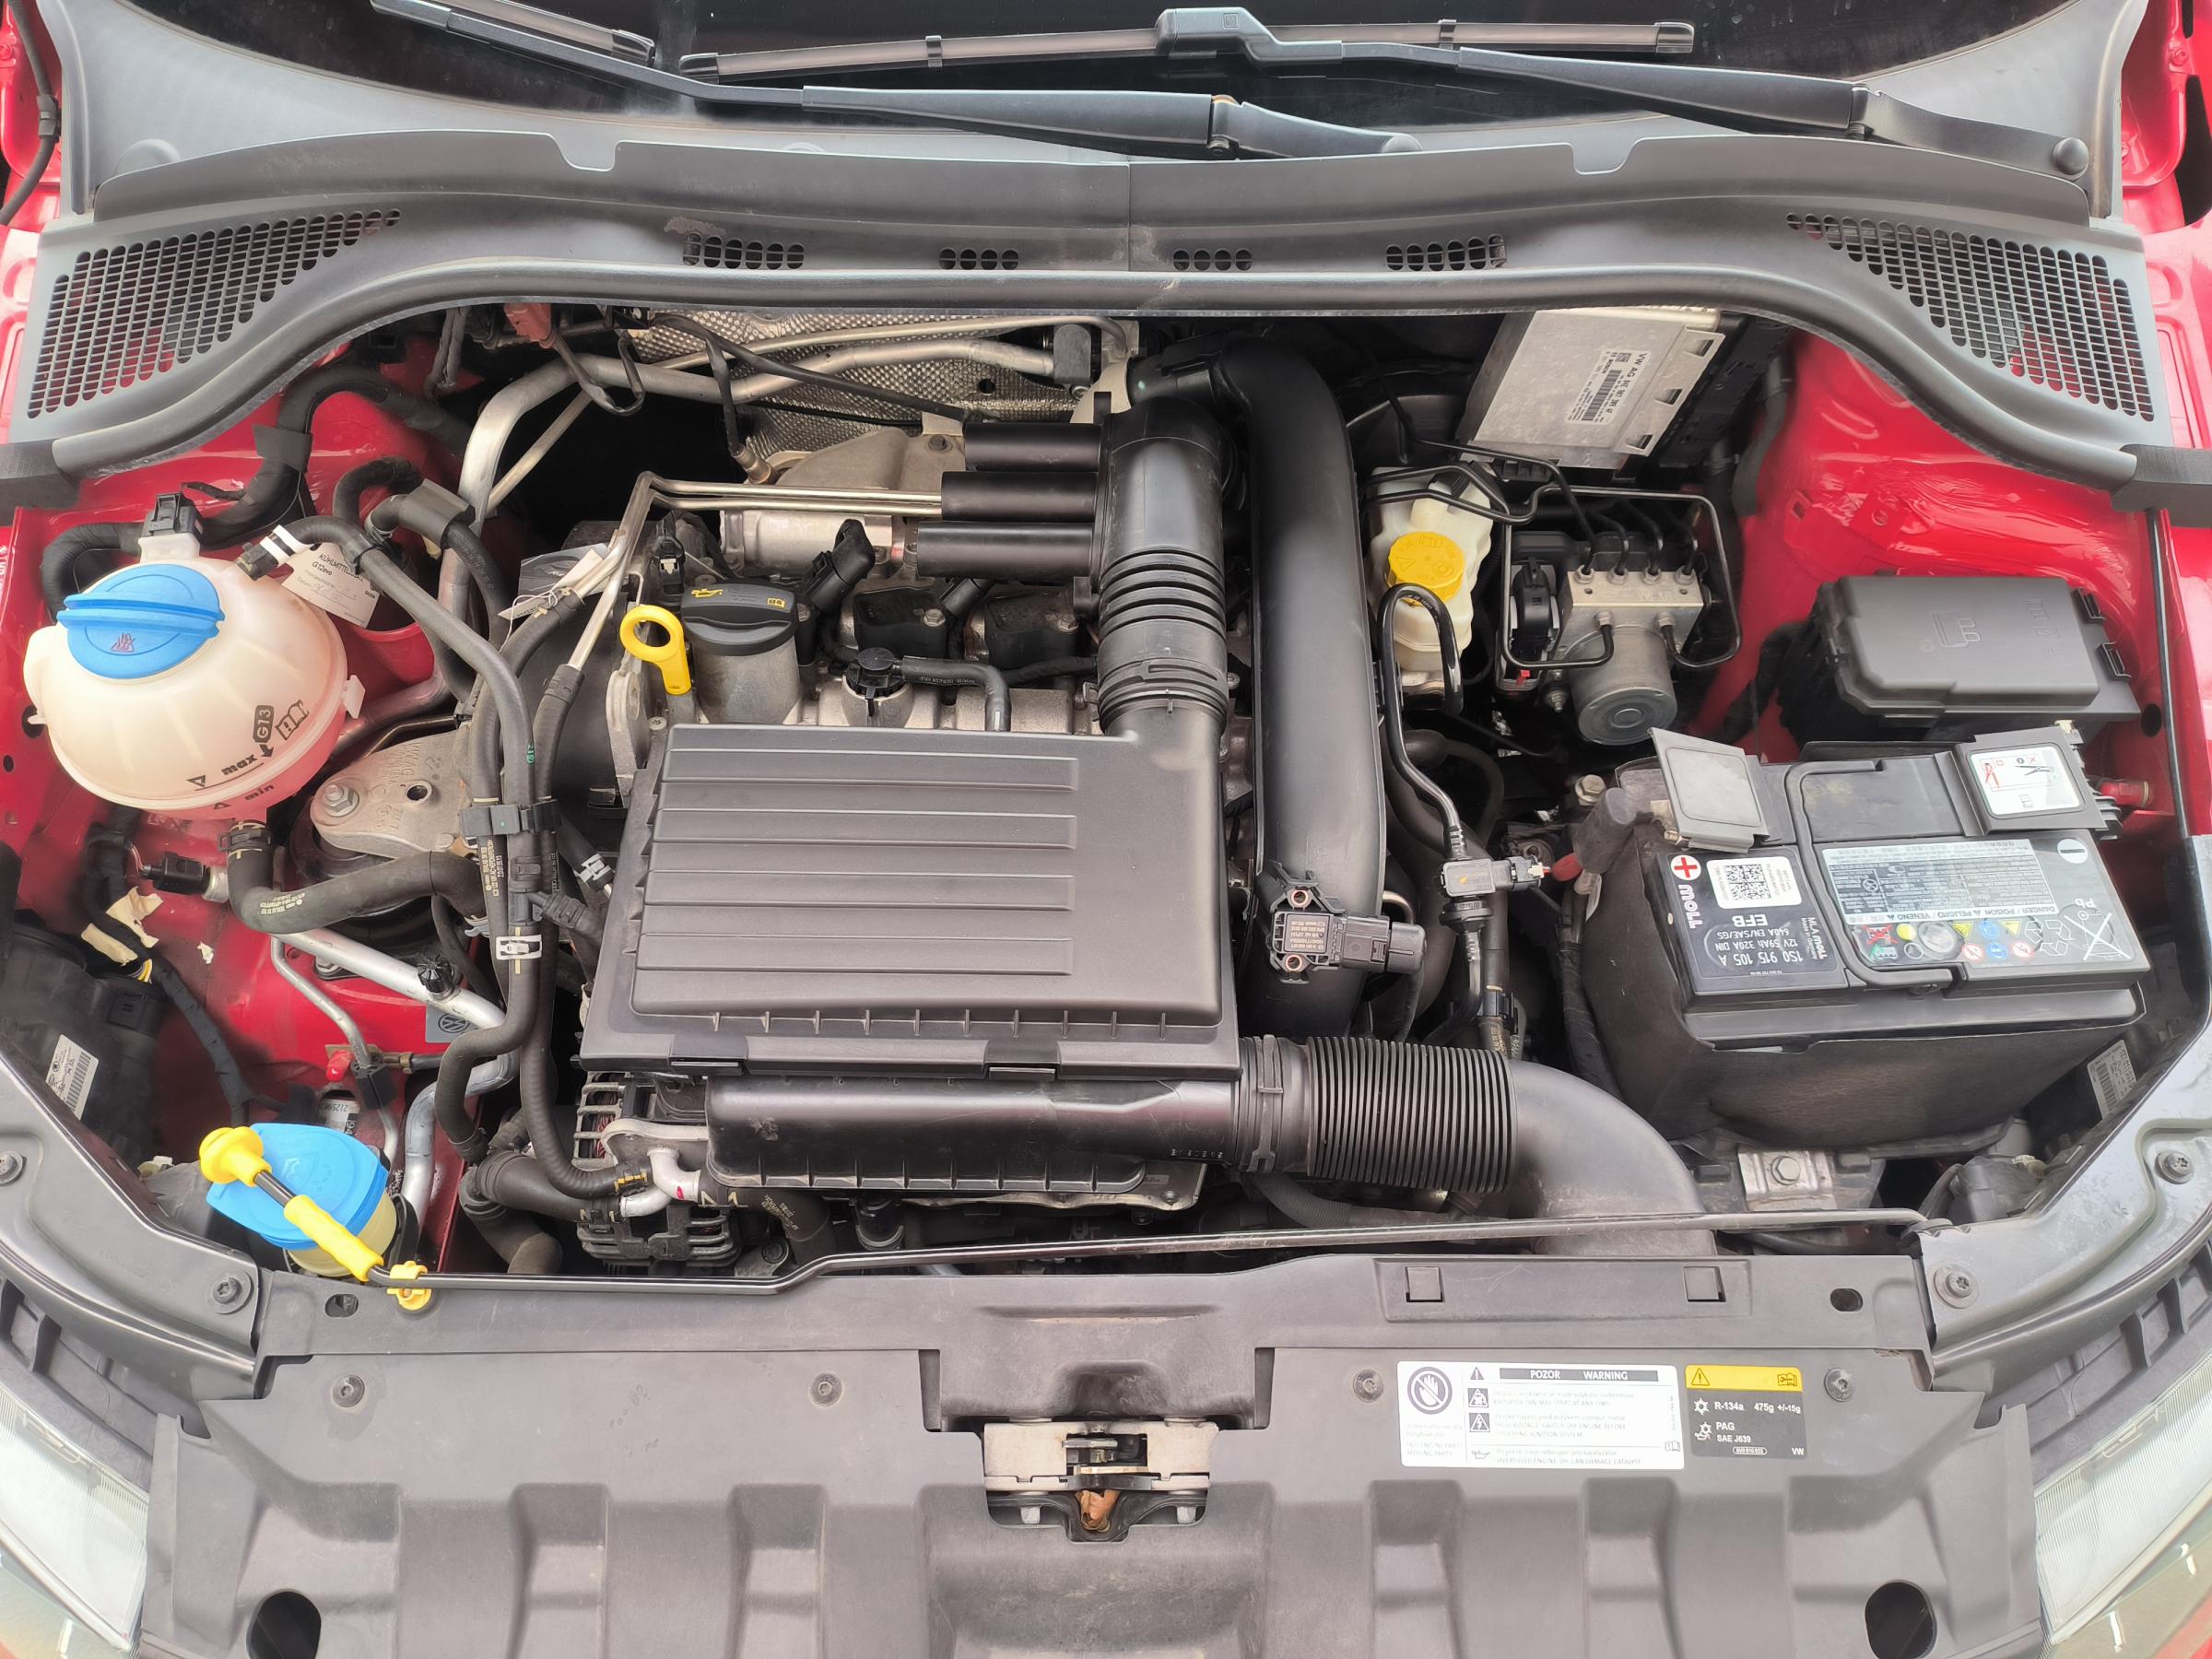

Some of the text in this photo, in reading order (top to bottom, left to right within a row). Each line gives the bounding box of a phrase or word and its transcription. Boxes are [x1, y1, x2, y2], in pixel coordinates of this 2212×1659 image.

[256, 708, 272, 738] G13
[220, 754, 258, 776] max
[243, 784, 275, 801] min
[2074, 897, 2097, 909] Pb
[1732, 913, 1768, 927] EFB
[1717, 928, 1765, 938] EN/SAE/GS
[1714, 941, 1729, 951] DIN
[1732, 940, 1755, 949] 320A
[1783, 937, 1799, 947] 12V
[1718, 954, 1727, 967] A
[1733, 953, 1753, 966] 105
[1757, 951, 1778, 965] 915
[1530, 1370, 1629, 1381] POZOR WARNING
[1713, 1401, 1801, 1414] R-134a 475g +/-15g
[1715, 1422, 1735, 1430] PAG
[1716, 1434, 1751, 1443] SAE J639
[1791, 1447, 1805, 1455] VW
